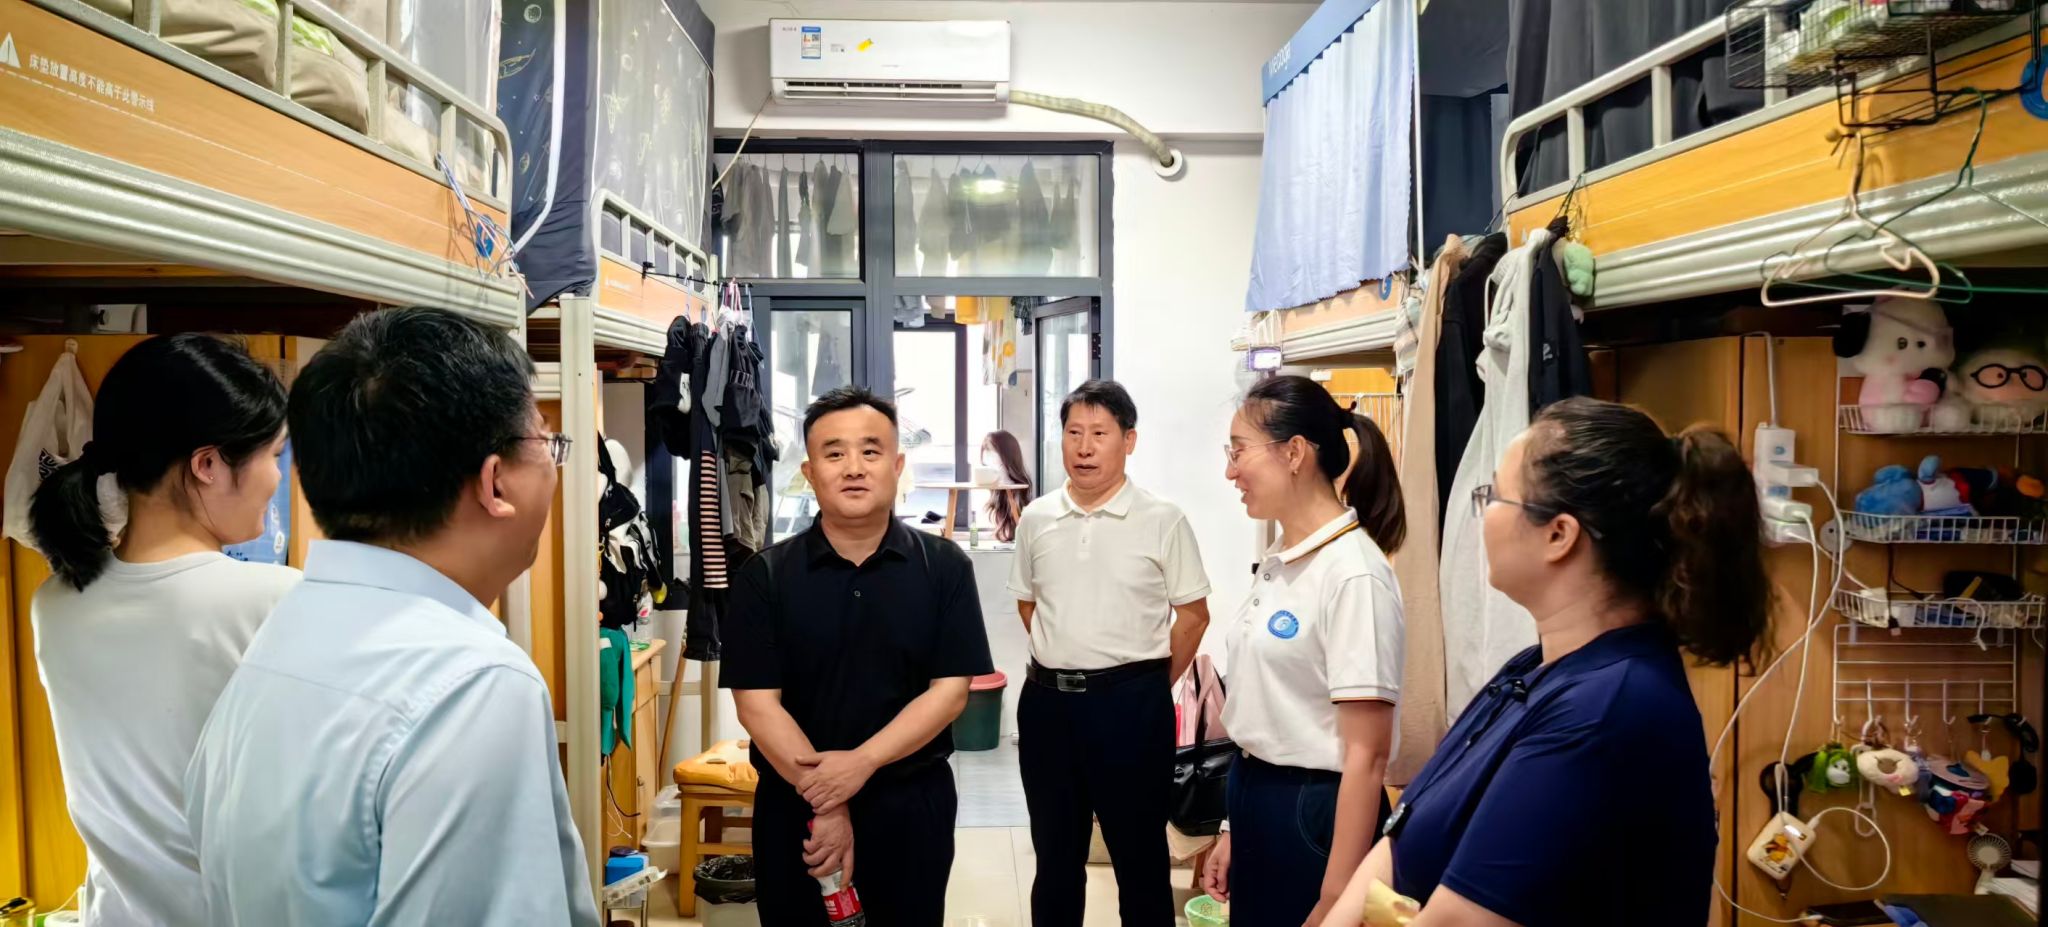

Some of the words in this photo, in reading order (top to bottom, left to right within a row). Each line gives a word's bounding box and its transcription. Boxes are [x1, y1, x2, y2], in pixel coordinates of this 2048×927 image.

[29, 54, 155, 113] 床垫放置高度不能高于此警示线
